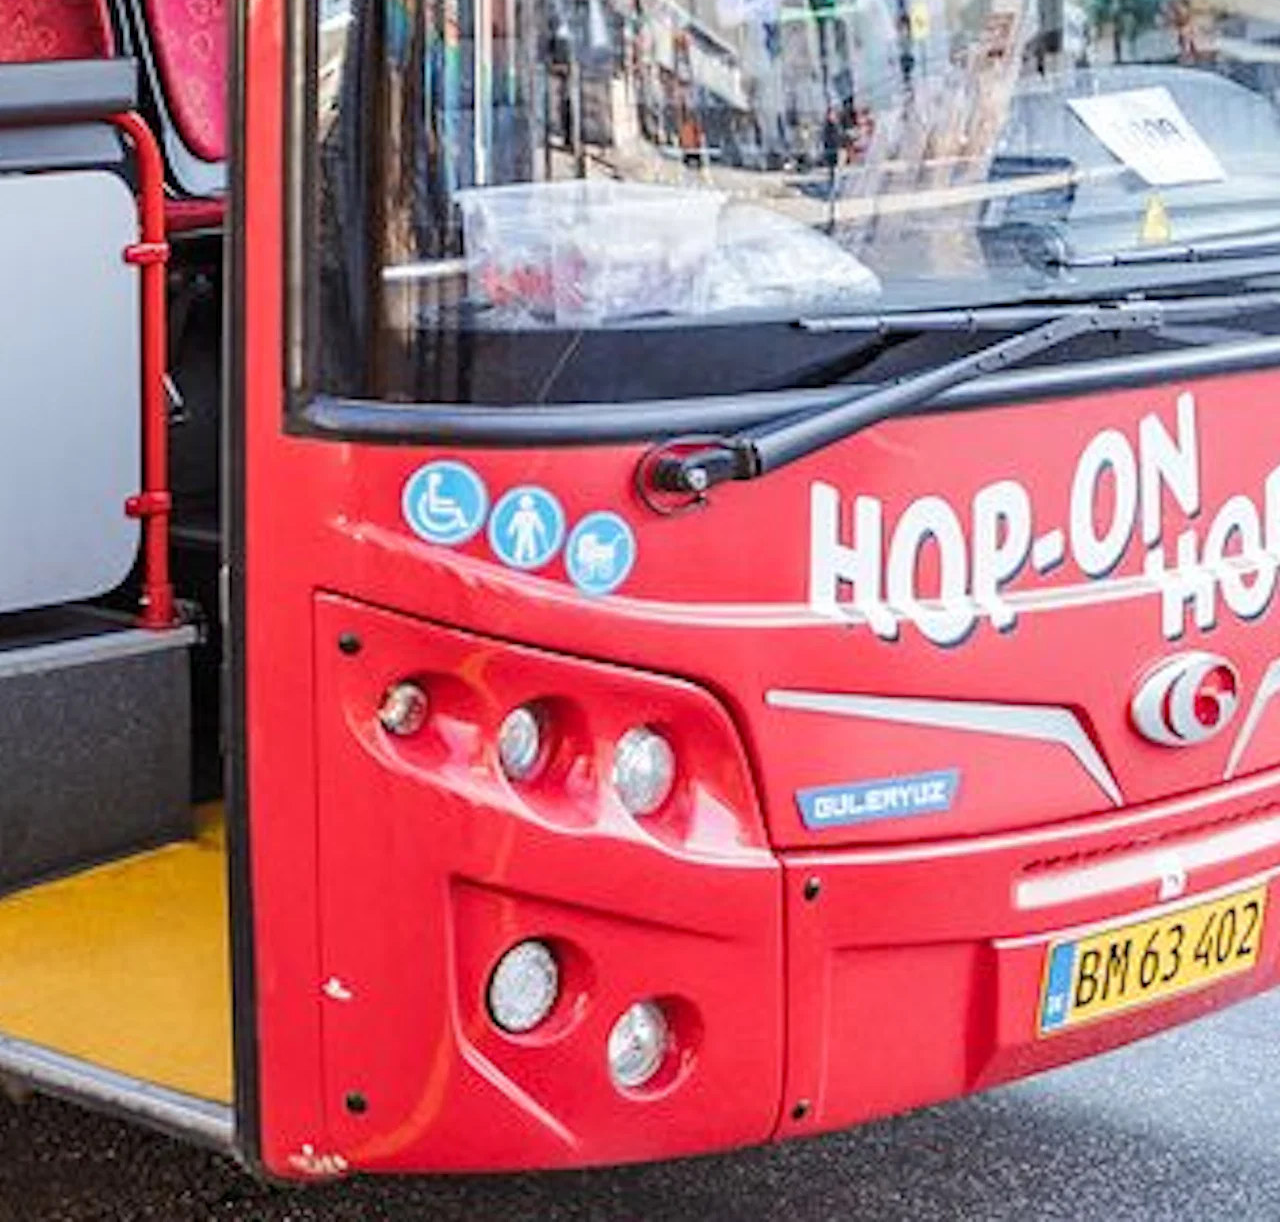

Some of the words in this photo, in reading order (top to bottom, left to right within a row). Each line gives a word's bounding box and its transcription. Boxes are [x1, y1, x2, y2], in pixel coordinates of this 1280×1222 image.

[810, 392, 1201, 648] HOP-ON
[1144, 468, 1280, 641] HO
[1075, 940, 1133, 1008] BM
[1140, 925, 1185, 989] 63
[1194, 900, 1259, 969] 402
